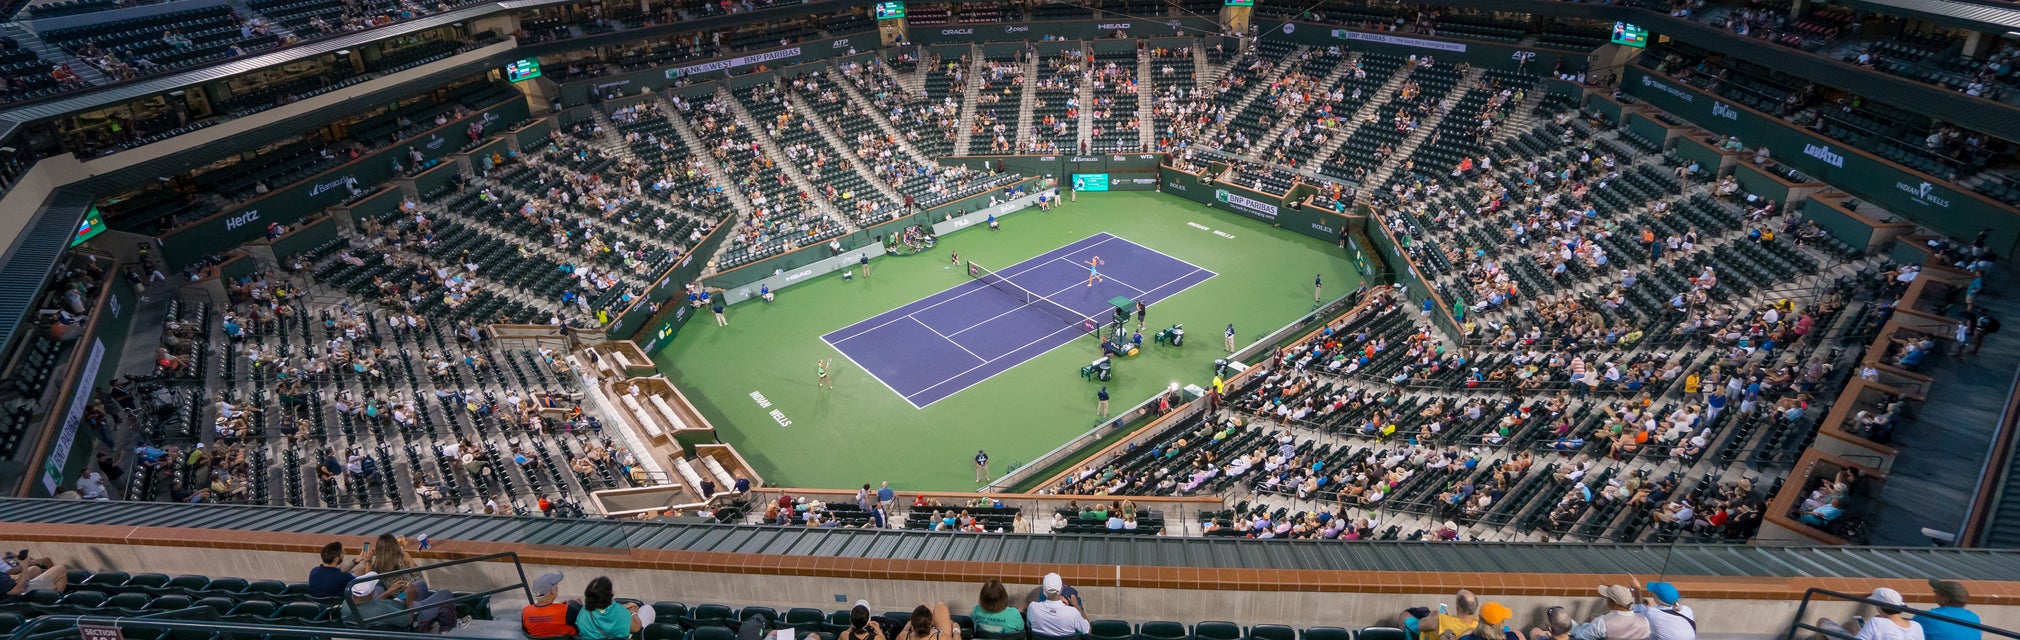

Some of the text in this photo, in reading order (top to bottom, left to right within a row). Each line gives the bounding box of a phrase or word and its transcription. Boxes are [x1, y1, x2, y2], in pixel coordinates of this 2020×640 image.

[1013, 25, 1029, 34] pepsi
[1361, 33, 1386, 41] PARIBAS
[833, 39, 849, 48] ATP
[679, 65, 702, 75] BANK
[710, 60, 732, 70] WEST
[744, 55, 761, 64] BNP
[763, 48, 799, 60] PARIBAS
[1652, 80, 1667, 92] TENNIS
[1803, 143, 1844, 169] LAVAZZA
[1169, 182, 1186, 191] ROLEX
[1895, 181, 1919, 197] INDIAN
[1926, 193, 1950, 208] WELLS
[1230, 195, 1275, 213] BNP PARIBAS
[226, 208, 259, 231] Hertz
[953, 218, 970, 228] FILA
[1187, 222, 1236, 239] INDIAN WELLS
[1312, 223, 1333, 234] ROLEX
[786, 269, 812, 281] HEAD
[1110, 341, 1120, 349] FILA
[749, 390, 792, 427] INDIAN WELLS
[84, 628, 118, 637] SECTION
